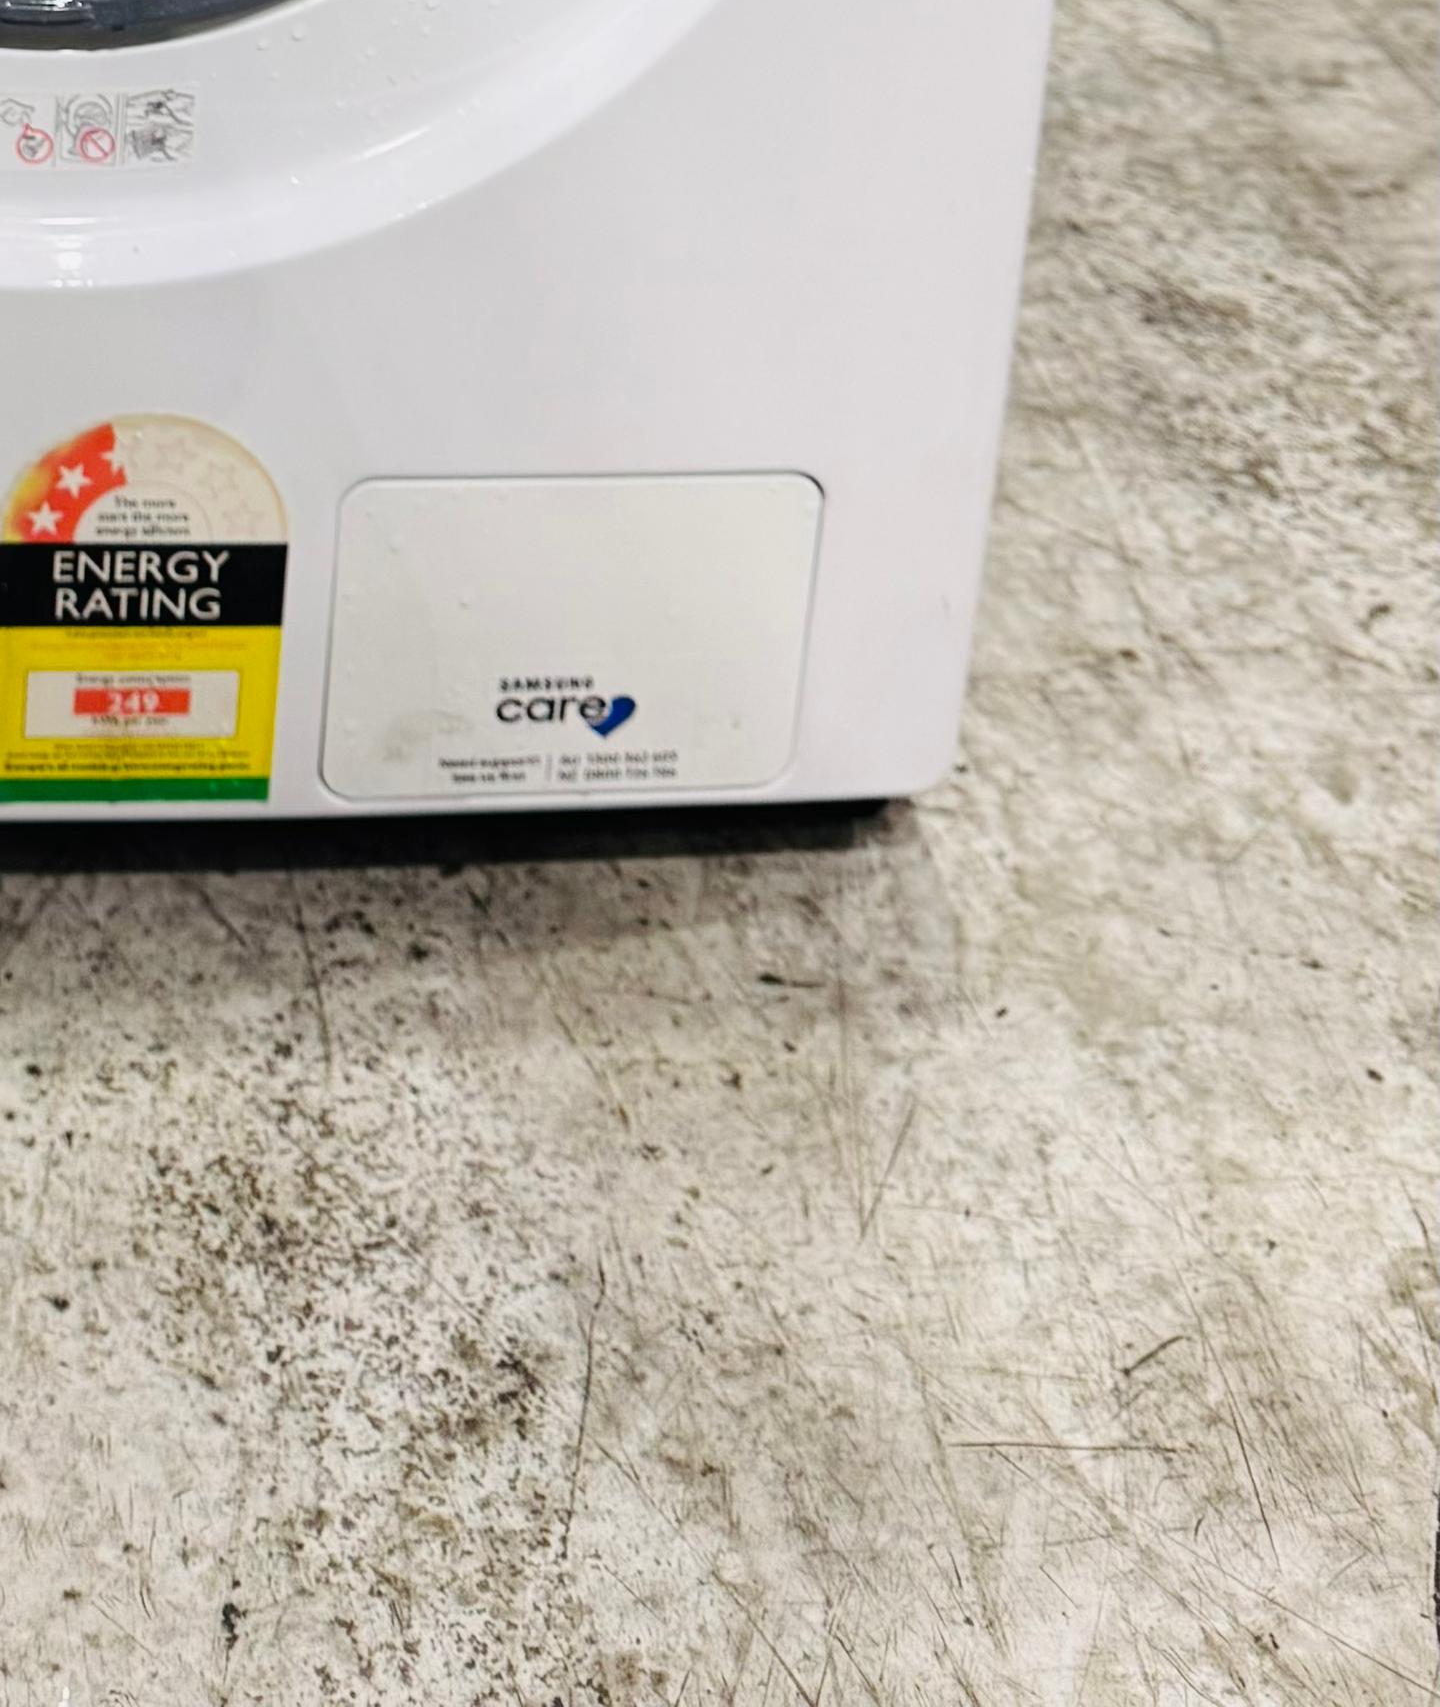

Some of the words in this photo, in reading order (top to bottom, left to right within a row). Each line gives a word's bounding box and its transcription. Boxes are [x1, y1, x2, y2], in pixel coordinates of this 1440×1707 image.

[52, 550, 229, 585] ENERGY
[54, 587, 221, 621] RATING
[496, 695, 607, 723] care
